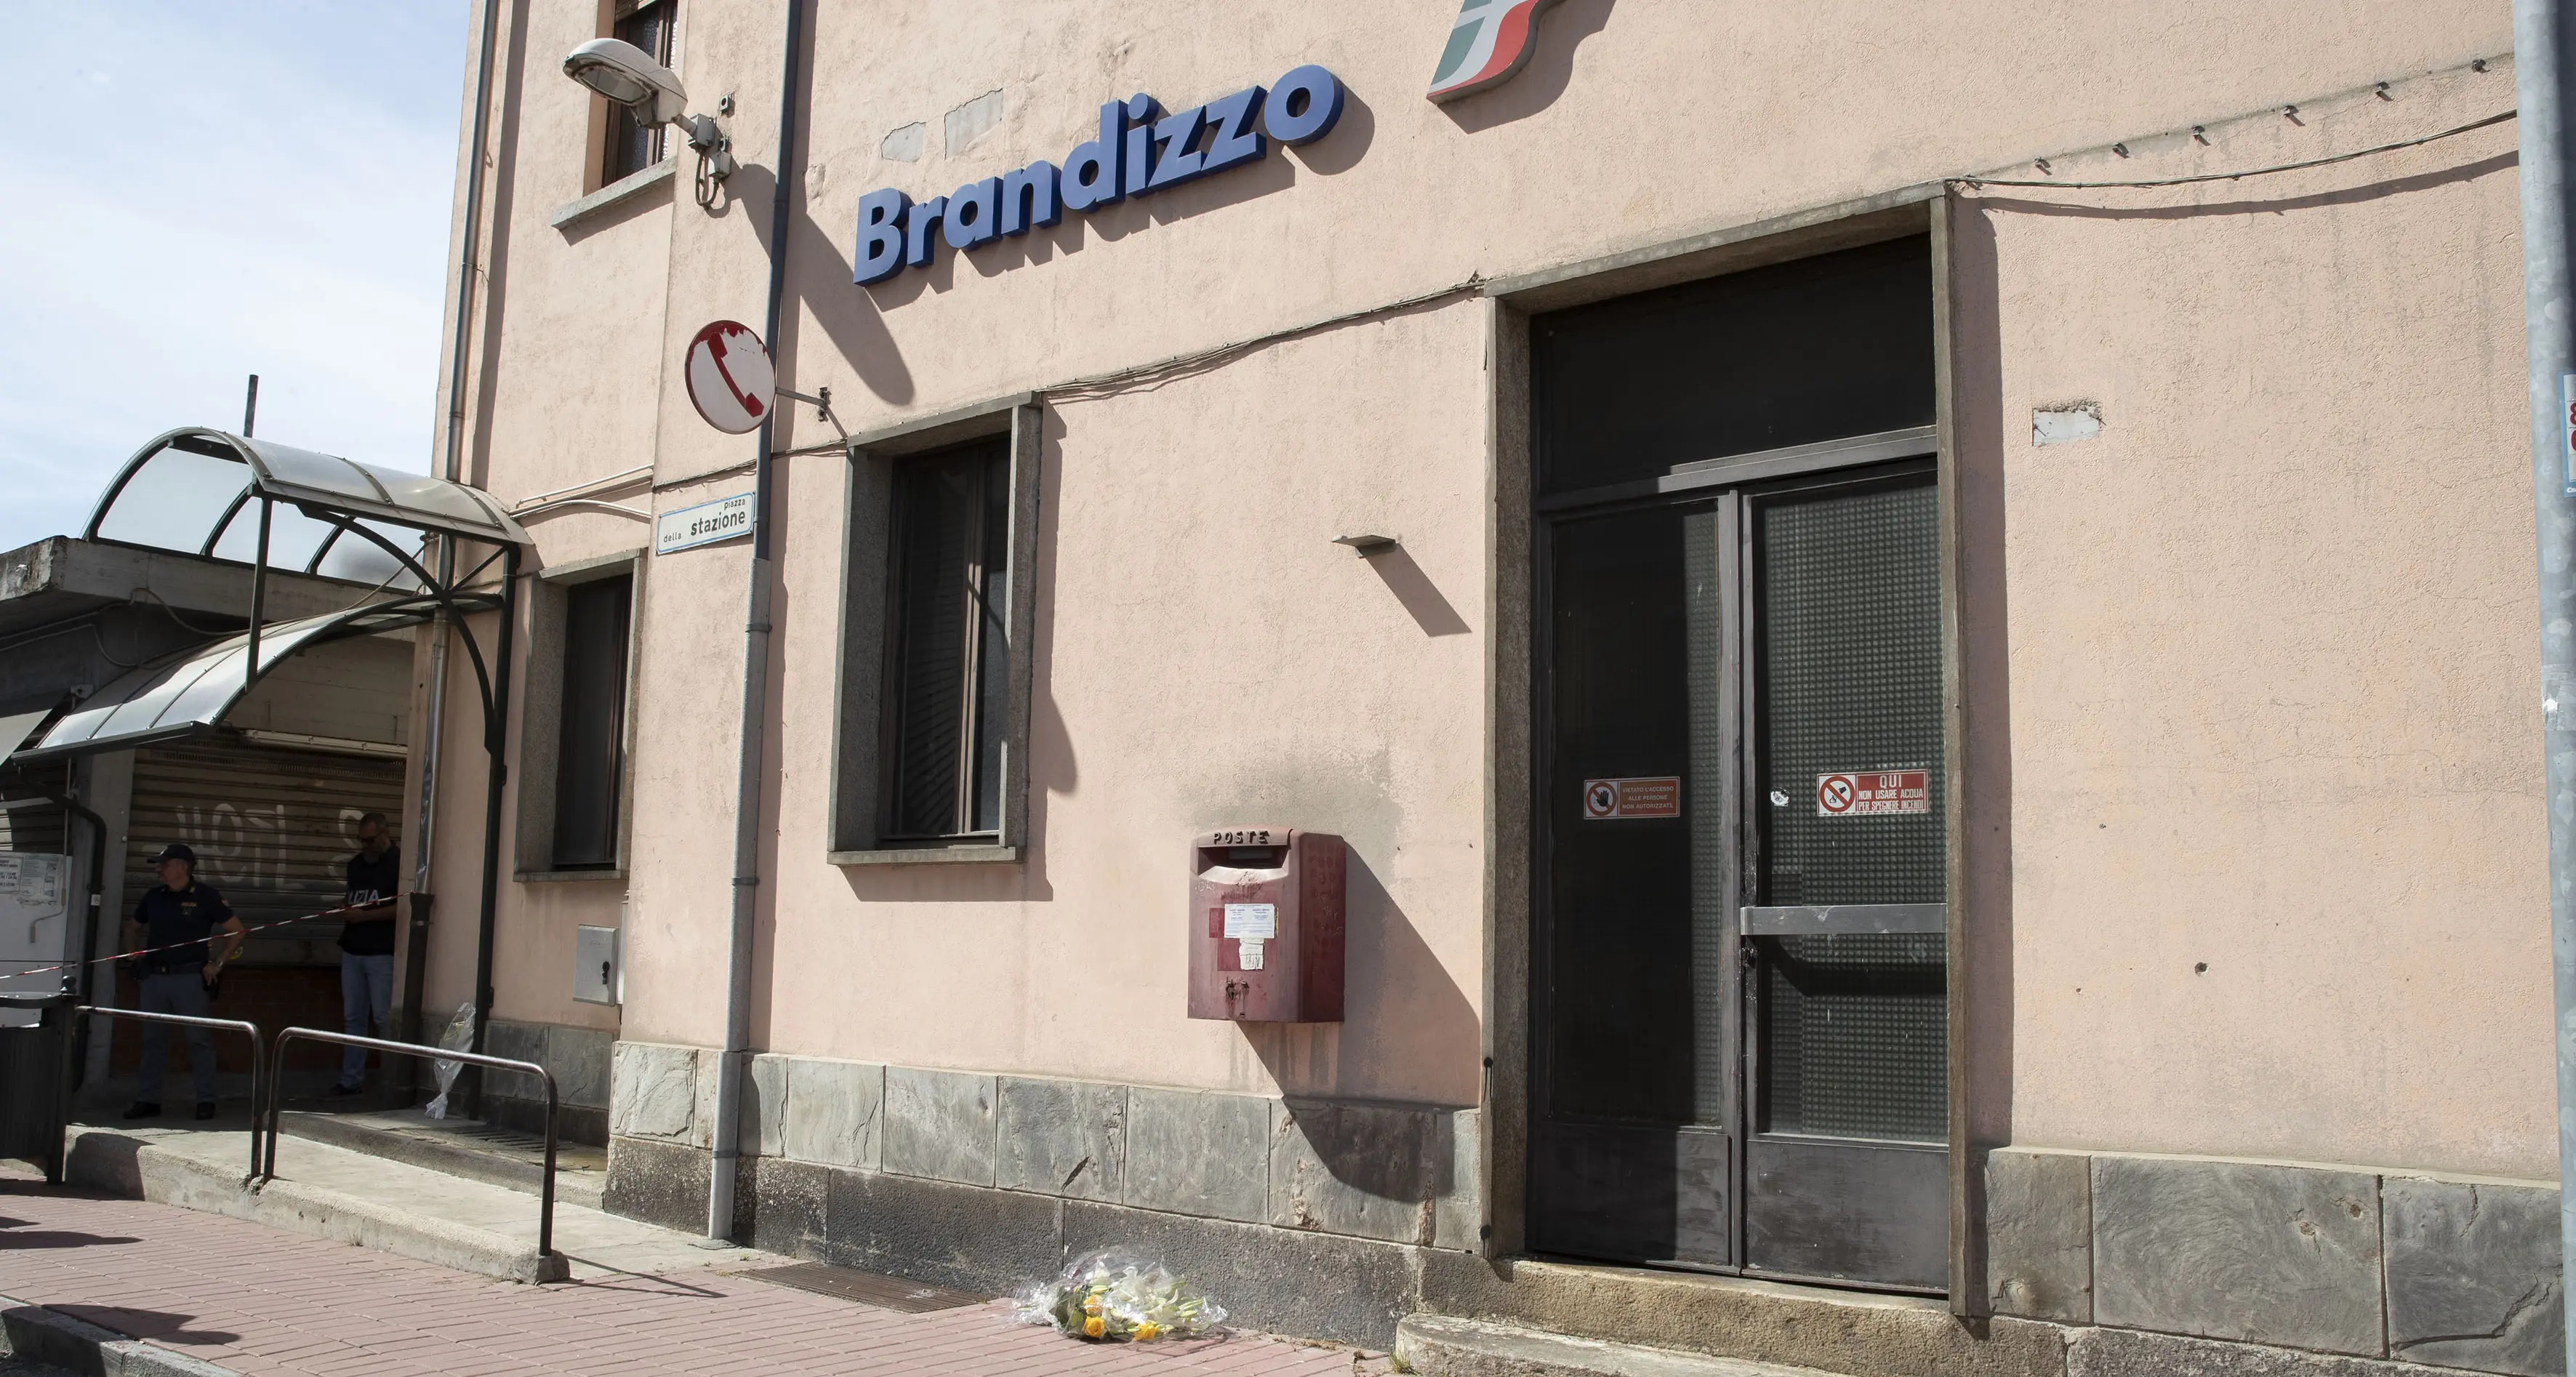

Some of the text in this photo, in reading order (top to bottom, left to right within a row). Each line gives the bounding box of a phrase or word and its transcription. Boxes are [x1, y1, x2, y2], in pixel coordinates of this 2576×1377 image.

[853, 64, 1344, 286] Brandizzo
[724, 498, 745, 510] piazza
[664, 510, 745, 543] della stazione
[1879, 774, 1902, 788] QUI
[1858, 788, 1924, 800] NON USARE ACQUA
[1858, 800, 1924, 811] PER SPEGNERE INCENDI
[1213, 830, 1270, 845] POSTE
